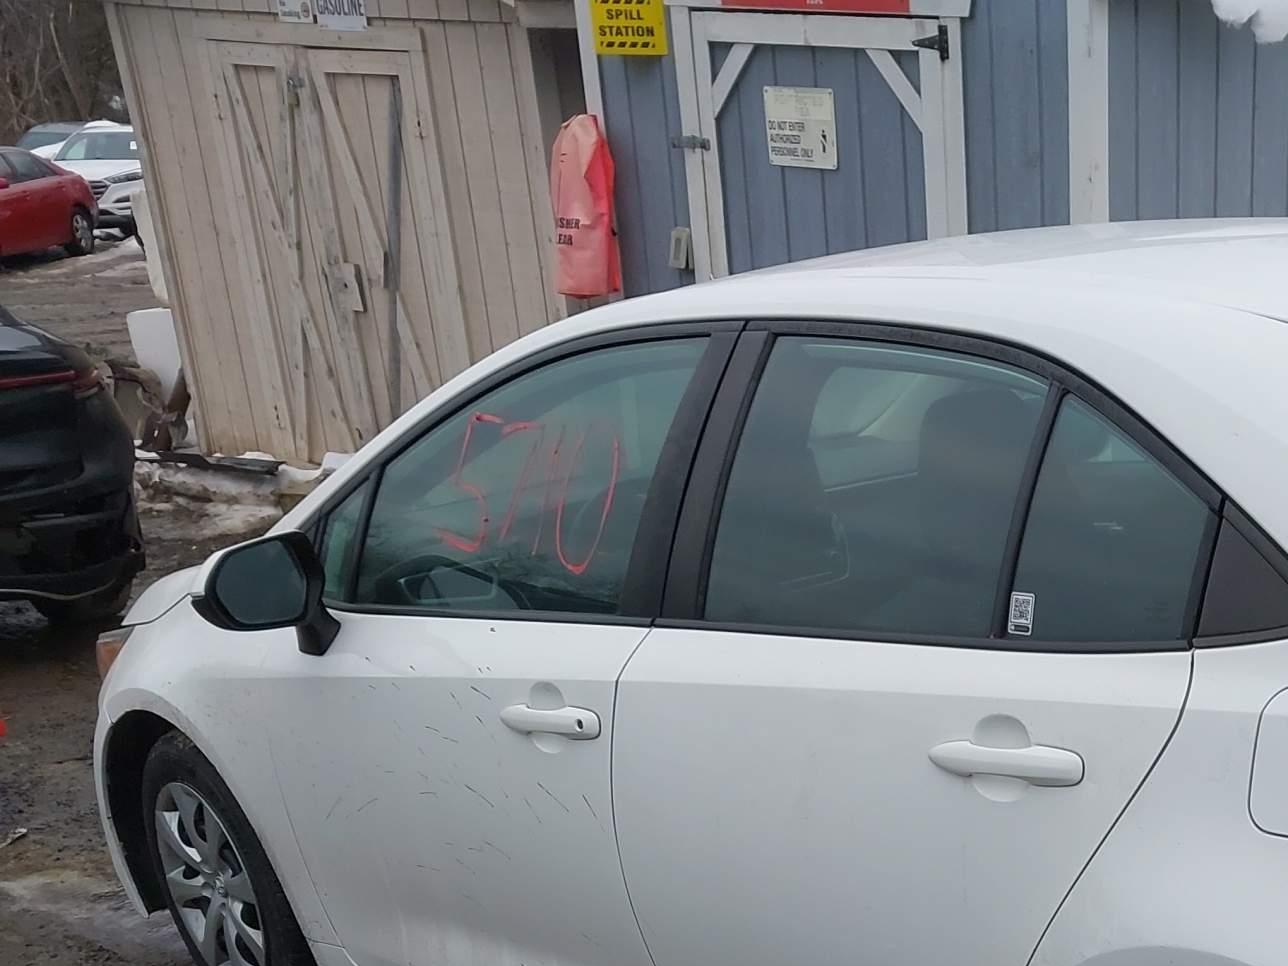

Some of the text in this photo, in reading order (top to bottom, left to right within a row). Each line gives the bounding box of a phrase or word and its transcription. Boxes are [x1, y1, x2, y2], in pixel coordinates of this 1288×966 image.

[316, 0, 365, 16] GASOLINE
[606, 9, 644, 20] SPILL
[599, 25, 655, 37] STATION
[788, 121, 806, 132] ENTER
